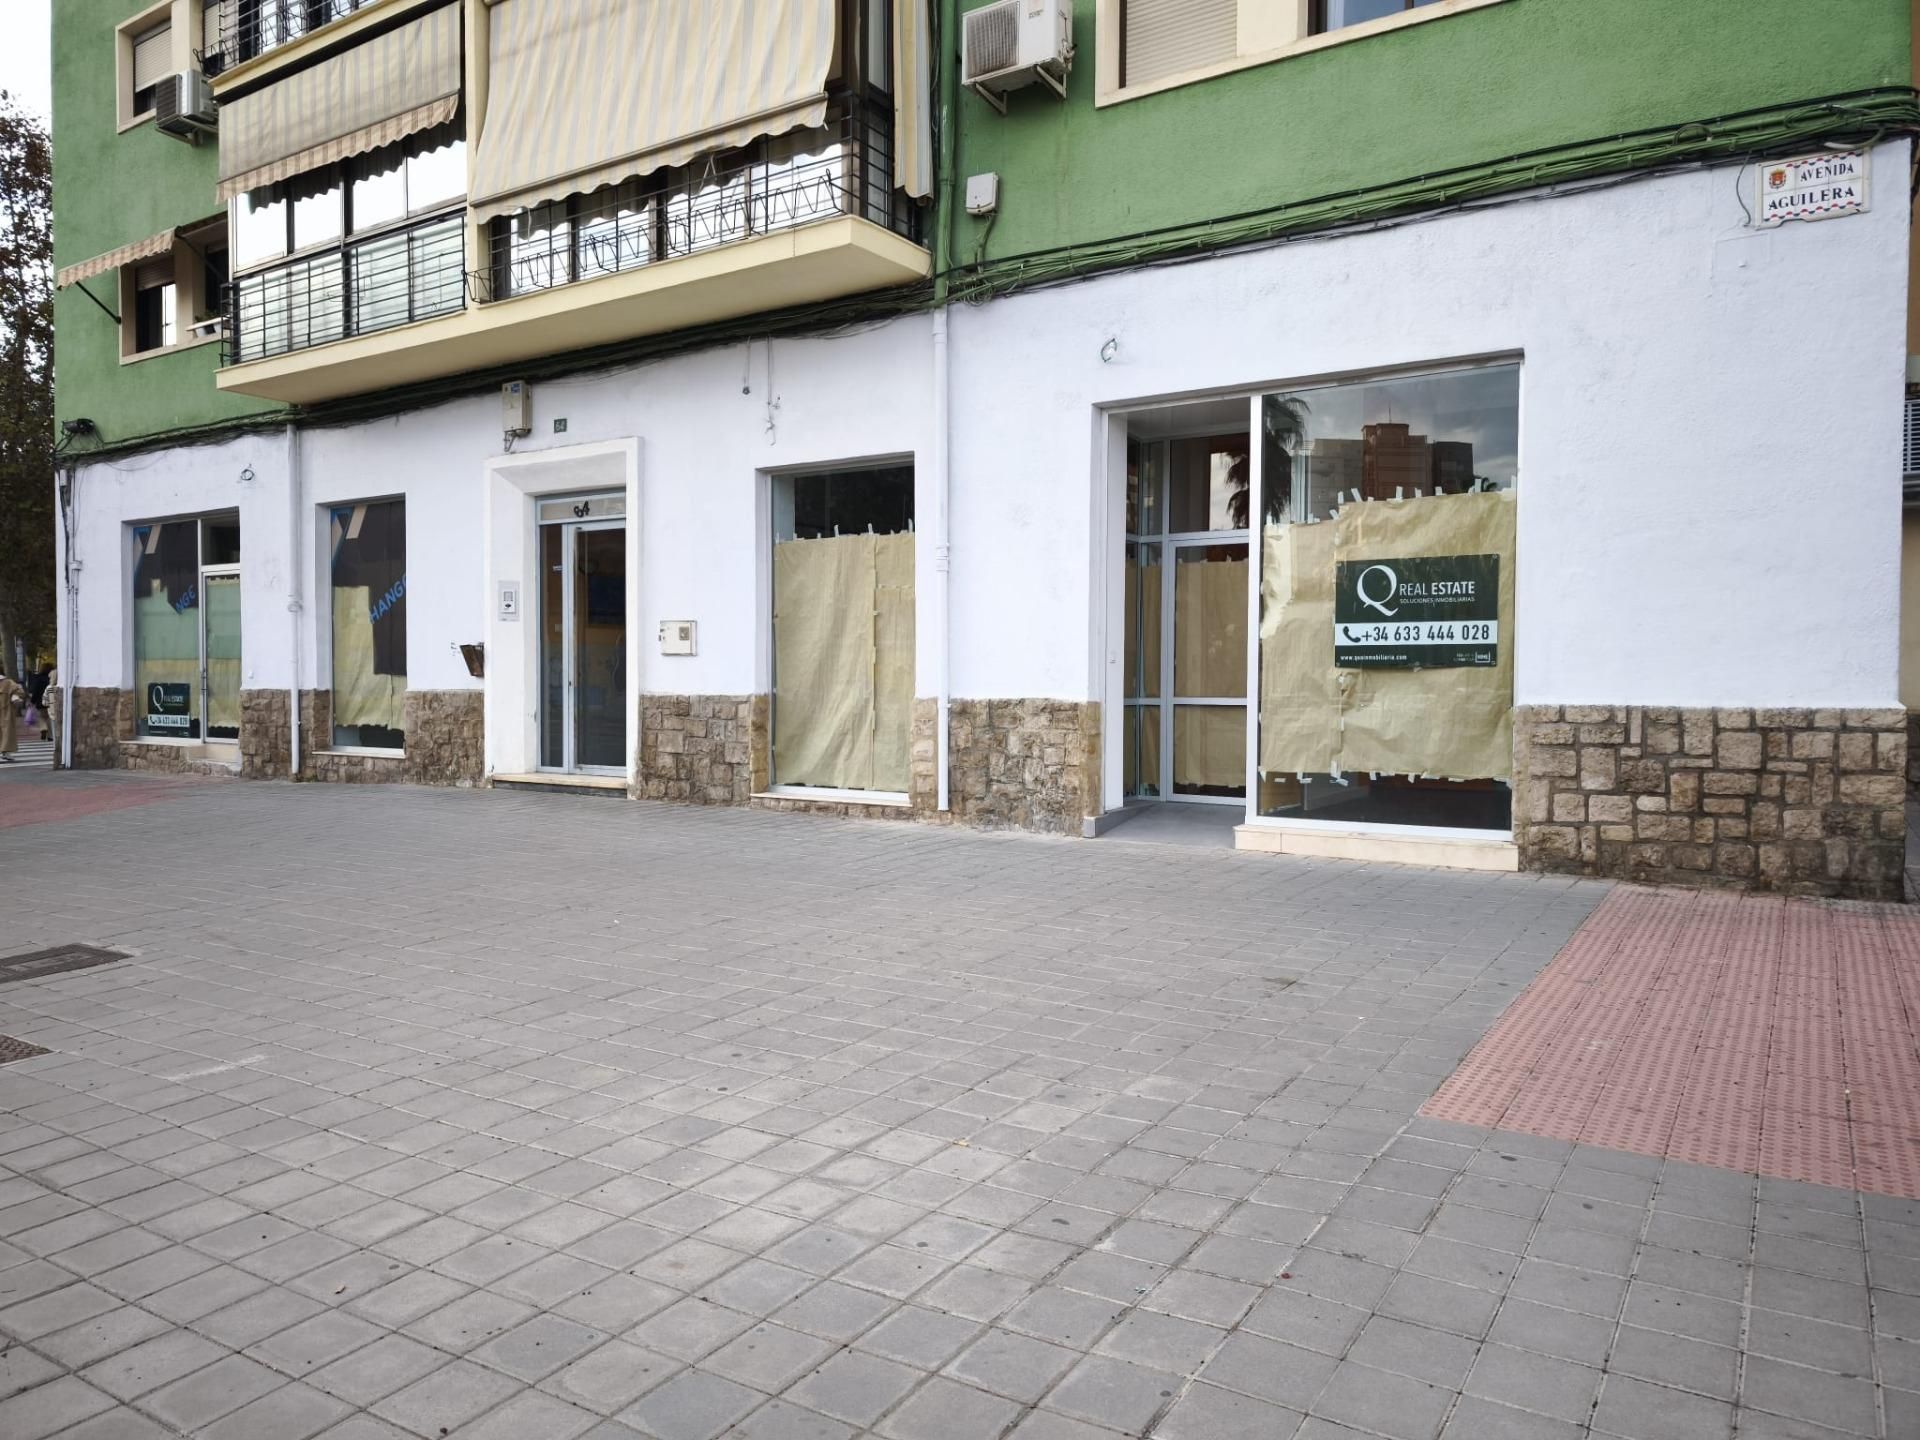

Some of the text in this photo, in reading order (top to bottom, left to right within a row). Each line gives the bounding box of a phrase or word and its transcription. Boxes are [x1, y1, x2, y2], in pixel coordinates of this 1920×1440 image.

[1800, 163, 1854, 182] AVENIDA
[1768, 187, 1855, 210] AGUILERA
[573, 500, 590, 518] 64
[1356, 564, 1399, 617] Q
[1399, 581, 1475, 596] REAL ESTATE
[1361, 624, 1490, 642] +34 633 444 028
